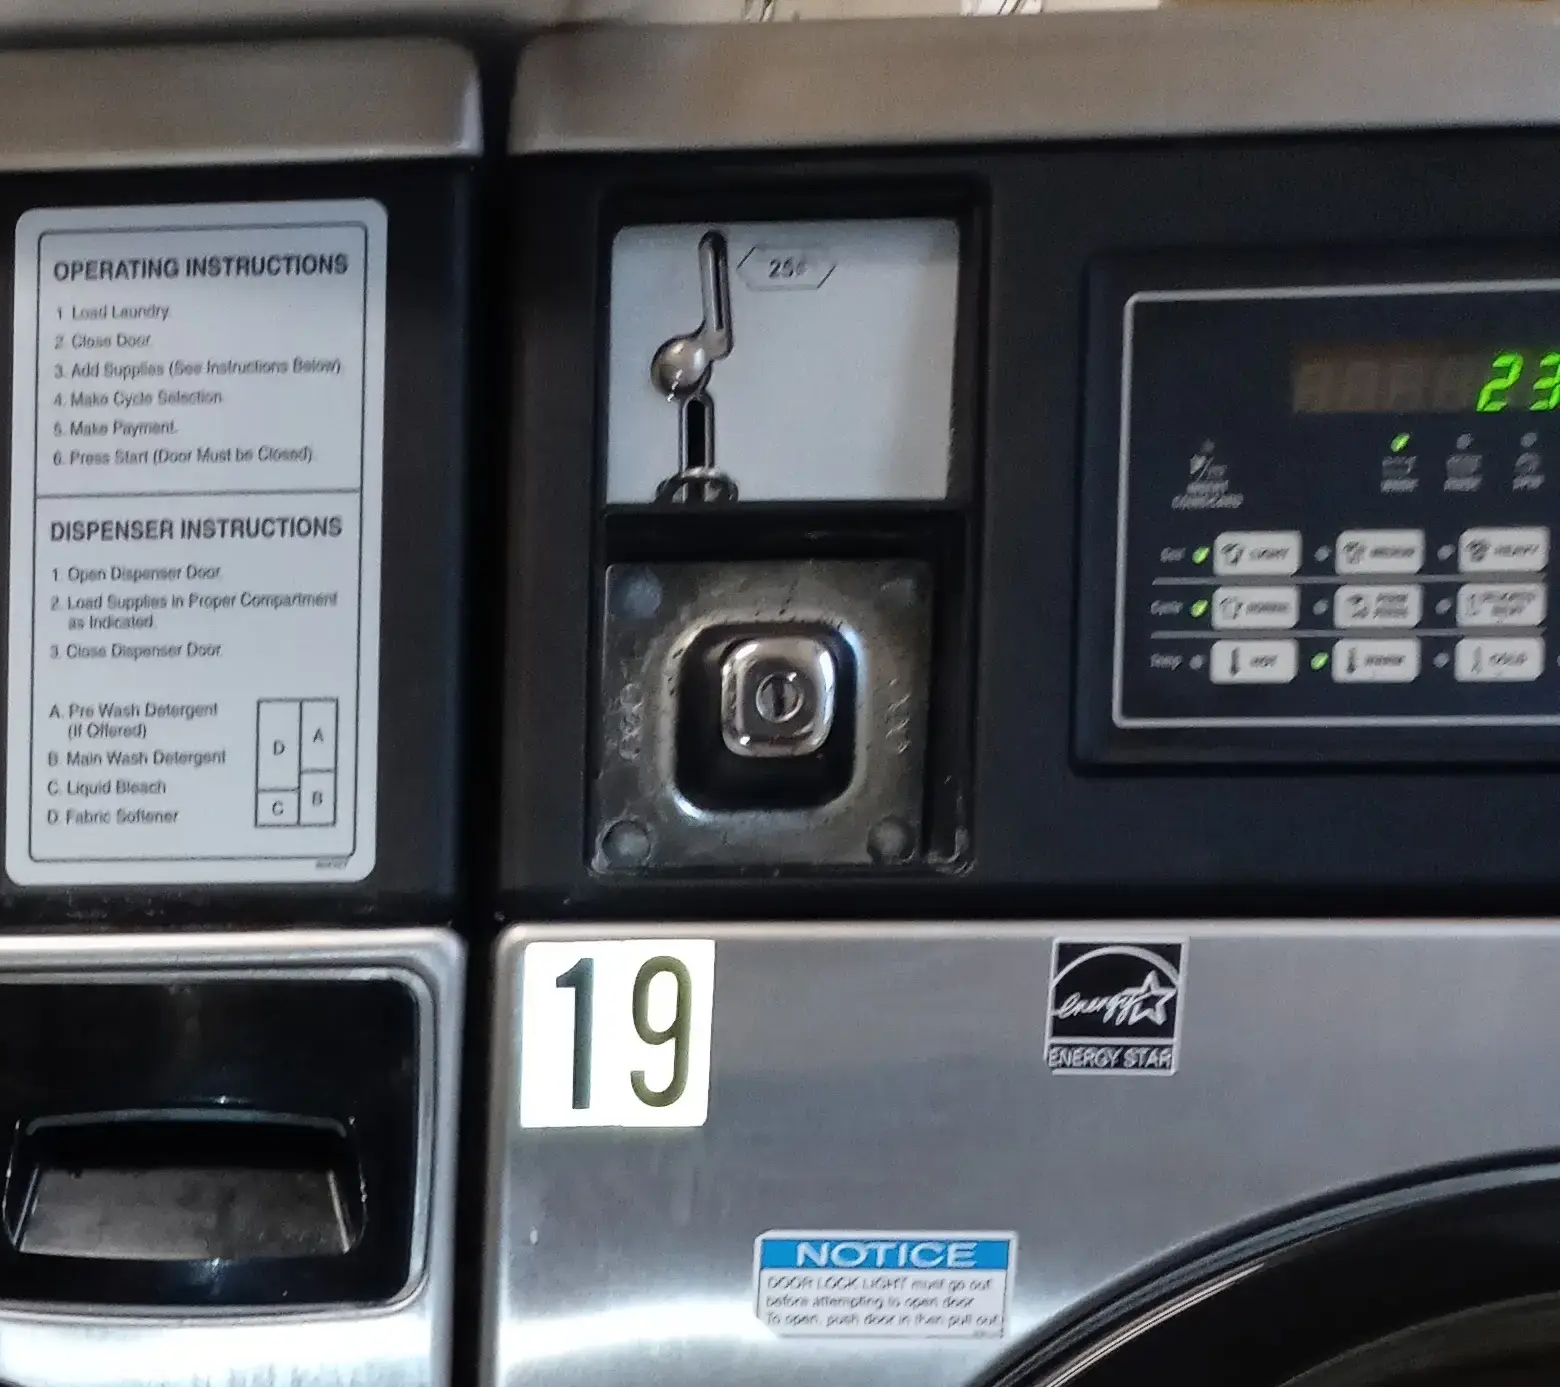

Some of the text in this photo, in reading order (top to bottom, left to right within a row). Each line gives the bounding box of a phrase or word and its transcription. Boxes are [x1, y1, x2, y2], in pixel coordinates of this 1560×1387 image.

[54, 253, 349, 281] OPERATING INSTRUCTIONS
[72, 305, 107, 320] Load
[72, 334, 111, 349] Close
[72, 362, 99, 378] Add
[104, 361, 164, 380] Supplies
[169, 359, 202, 380] (See
[207, 359, 288, 376] Instructions
[1475, 351, 1560, 413] 23
[71, 391, 108, 407] Make
[114, 390, 153, 408] Cycle
[70, 420, 108, 436] Make
[70, 450, 110, 465] Press
[115, 449, 148, 464] Start
[153, 448, 191, 466] (Door
[197, 447, 230, 462] Must
[236, 448, 253, 462] be
[50, 515, 343, 543] DISPENSER INSTRUCTIONS
[68, 566, 106, 583] Open
[111, 565, 181, 583] Dispenser
[68, 595, 102, 610] Load
[108, 594, 167, 612] Supplies
[189, 592, 236, 612] Proper
[241, 591, 338, 610] Compartment
[68, 617, 85, 631] as
[67, 643, 107, 659] Close
[111, 643, 182, 661] Dispenser
[69, 703, 94, 718] Pre
[98, 703, 139, 718] Wash
[145, 702, 218, 720] Detergent
[87, 721, 147, 739] Offered)
[313, 728, 324, 743] A
[273, 740, 285, 756] D
[67, 750, 102, 766] Main
[107, 750, 148, 765] Wash
[153, 749, 226, 767] Detergent
[67, 779, 111, 797] Liquid
[116, 778, 166, 795] Bleach
[312, 791, 323, 806] B
[66, 809, 110, 825] Fabric
[117, 808, 179, 825] Softener
[272, 801, 284, 816] C
[556, 955, 692, 1109] 19
[1048, 1046, 1172, 1069] ENERGY STAR
[796, 1241, 978, 1268] NOTICE
[767, 1276, 992, 1293] DOOR LOCK LIGHT must go out
[766, 1294, 809, 1308] before
[812, 1295, 884, 1311] attempting
[905, 1296, 938, 1311] open
[767, 1311, 781, 1324] To
[826, 1313, 859, 1328] push
[864, 1313, 895, 1325] door
[915, 1312, 943, 1325] then
[948, 1313, 972, 1329] pull
